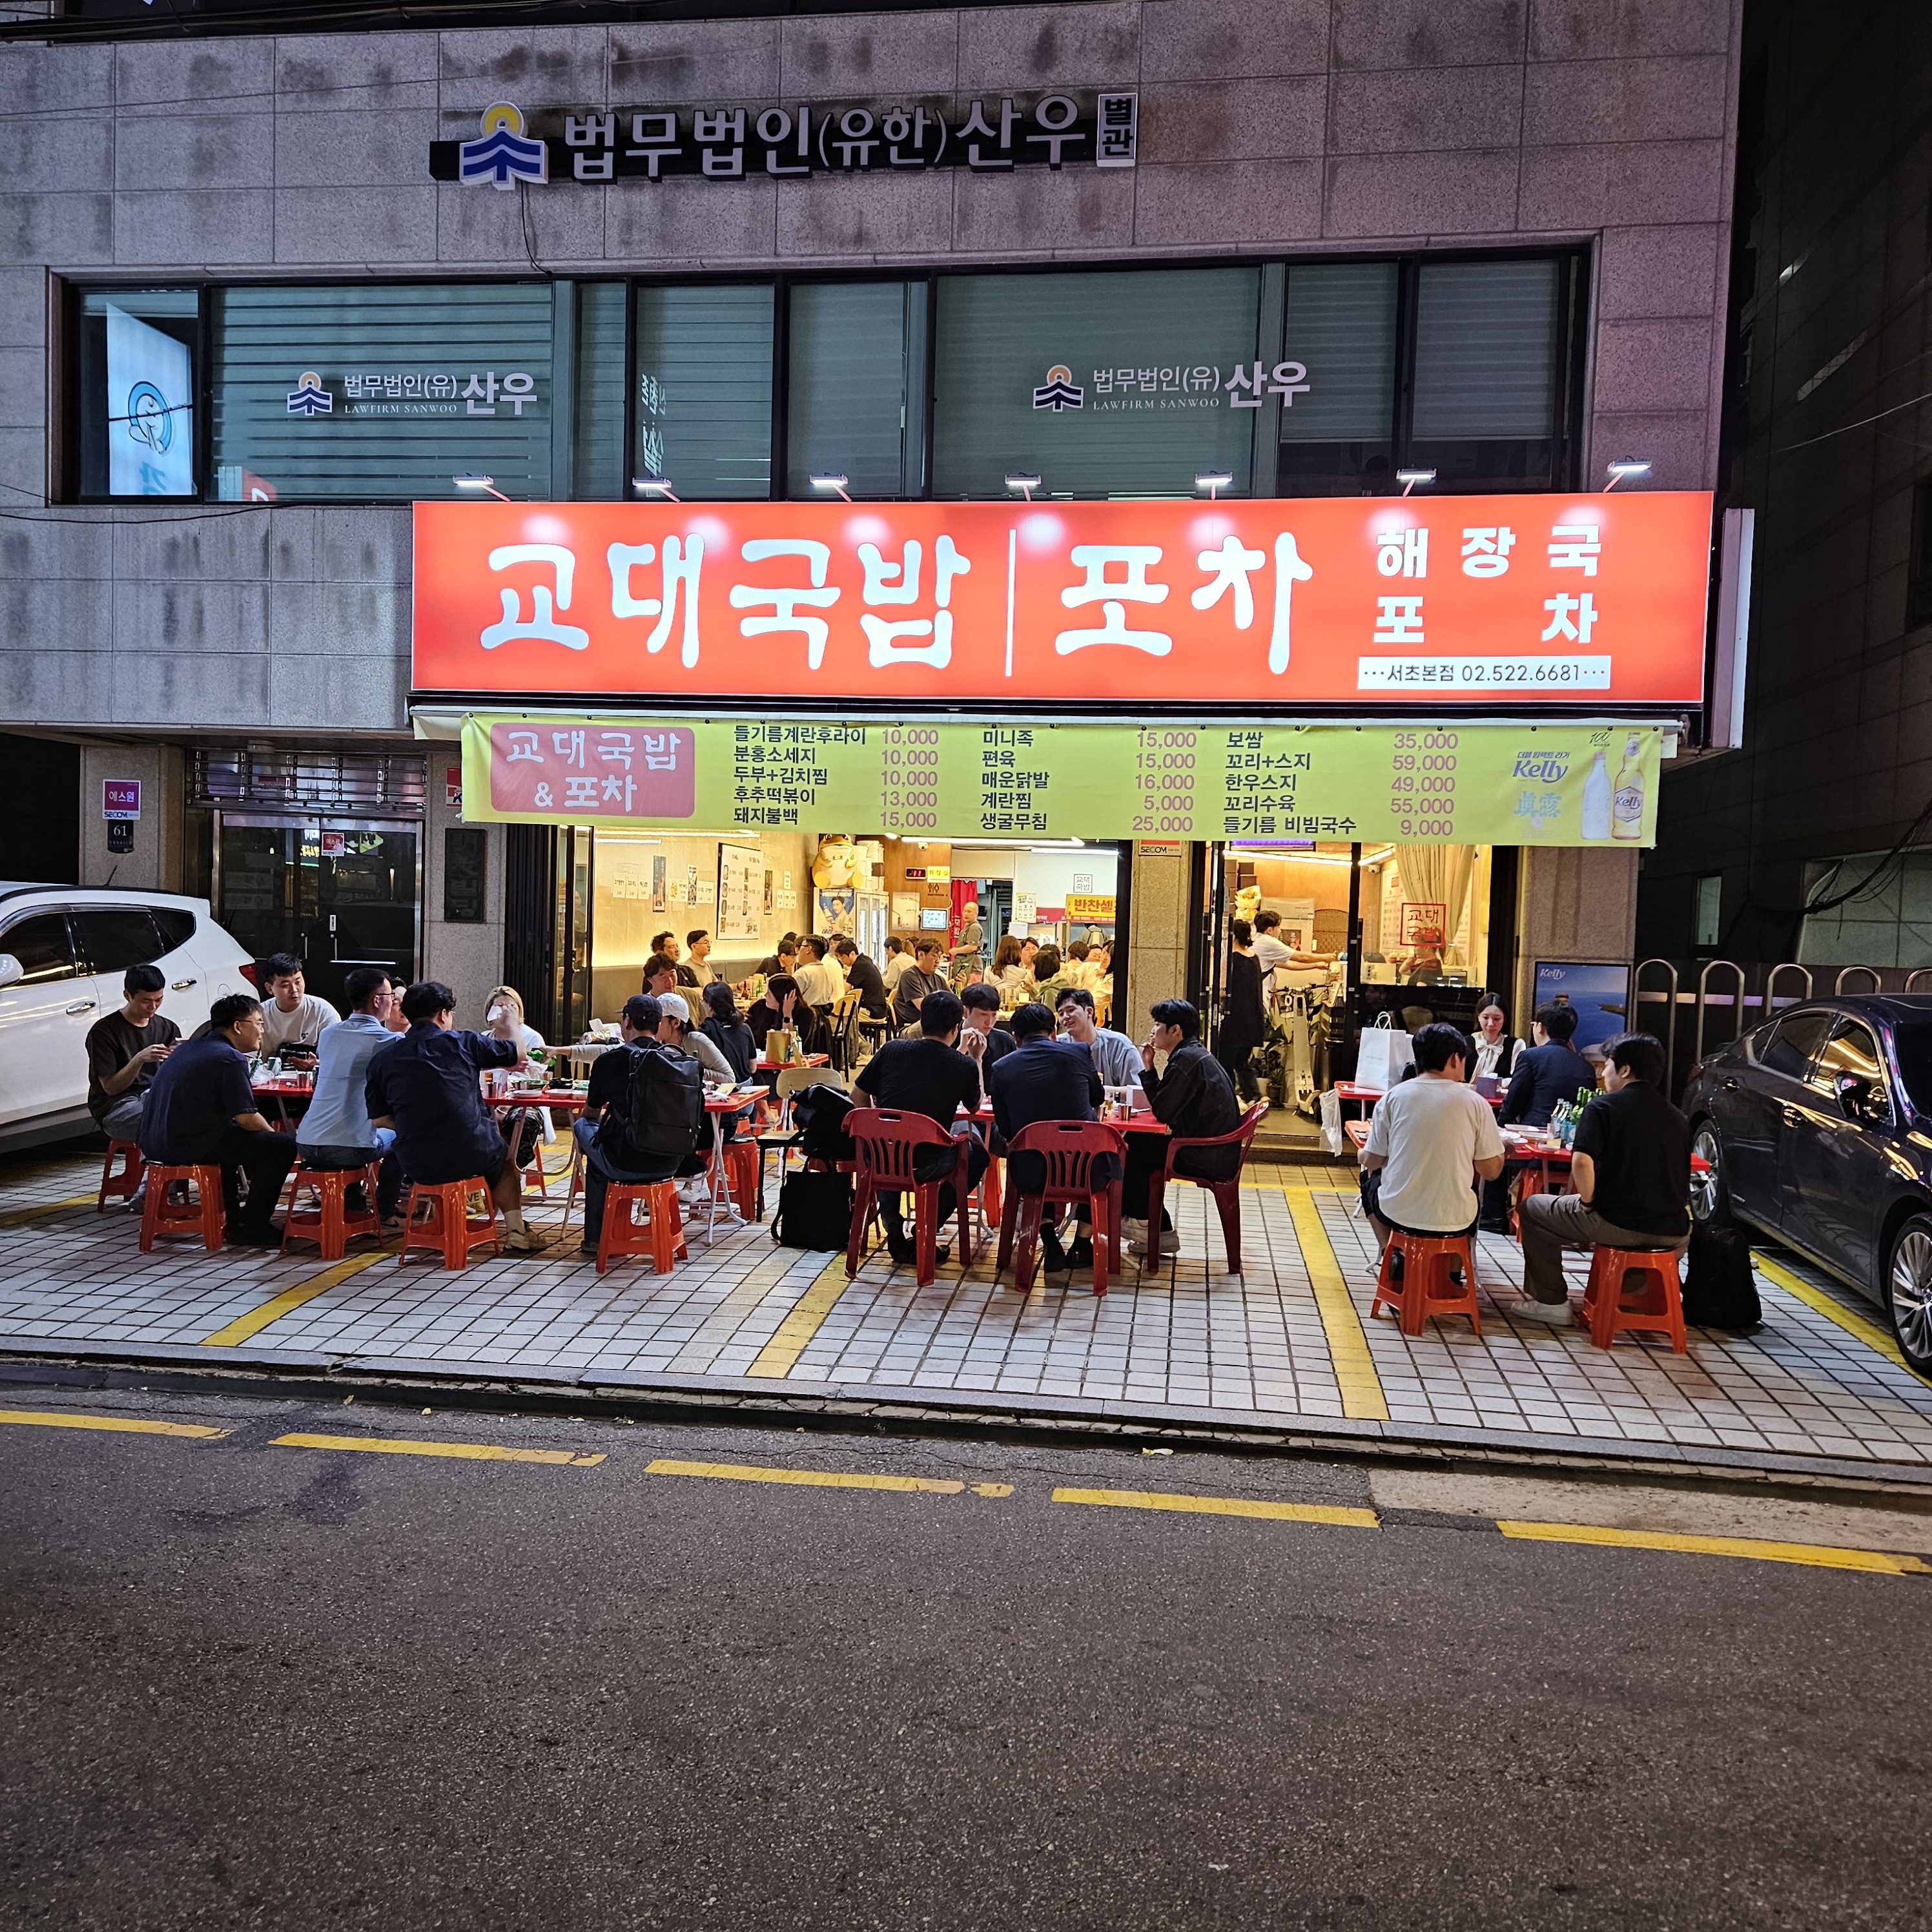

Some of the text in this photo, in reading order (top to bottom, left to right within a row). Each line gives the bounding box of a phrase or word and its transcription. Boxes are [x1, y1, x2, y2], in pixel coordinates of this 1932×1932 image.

[1102, 98, 1133, 156] 별관
[344, 371, 537, 416] 법무법인(유) 산우
[1093, 361, 1311, 409] 법무법인(유) 산우
[345, 403, 457, 414] LAWFIRM SANWOO
[1093, 398, 1220, 411] LAWFIRM SANWOO
[1375, 524, 1601, 578] 해장국
[480, 531, 1313, 675] 교대국밥 포차
[1387, 664, 1579, 682] 서초본점 02.522.6681
[734, 724, 867, 746] 들기름계란후라이
[882, 728, 940, 746] 10,000
[983, 730, 1034, 748] 미니족
[1137, 732, 1197, 750] 15,000
[1226, 731, 1264, 750] 보쌈
[1393, 733, 1459, 752] 35,000
[506, 729, 681, 772] 교대국밥
[734, 746, 816, 766] 분홍소세지
[881, 749, 940, 768] 10,000
[981, 750, 1016, 768] 편육
[1136, 752, 1196, 771] 15,000
[1225, 752, 1311, 771] 꼬리+스지
[1392, 754, 1457, 773] 59,000
[1513, 759, 1569, 783] Kelly
[734, 766, 828, 786] 두부+김치찜
[881, 770, 939, 788] 10,000
[981, 771, 1050, 790] 매운닭발
[1135, 774, 1195, 792] 16,000
[1225, 774, 1297, 792] 한우스지
[1391, 776, 1456, 795] 49,000
[108, 791, 134, 803] 에스원
[534, 774, 638, 813] & 포차
[734, 786, 816, 807] 후추떡볶이
[880, 790, 938, 809] 13,000
[981, 792, 1032, 810] 계란찜
[1615, 796, 1642, 810] Kelly
[1144, 795, 1194, 814] 5,000
[1224, 795, 1296, 814] 꼬리수육
[1390, 797, 1455, 816] 55,000
[734, 807, 799, 826] 돼지불백
[879, 811, 938, 830] 15,000
[980, 812, 1047, 831] 생굴무침
[1132, 816, 1193, 834] 25,000
[1223, 816, 1357, 835] 들기름 비빔국수
[114, 825, 127, 836] 61
[1400, 819, 1454, 838] 9,000
[1074, 899, 1116, 913] 반찬셀
[1408, 909, 1439, 924] 교대
[1539, 968, 1566, 980] Kelly
